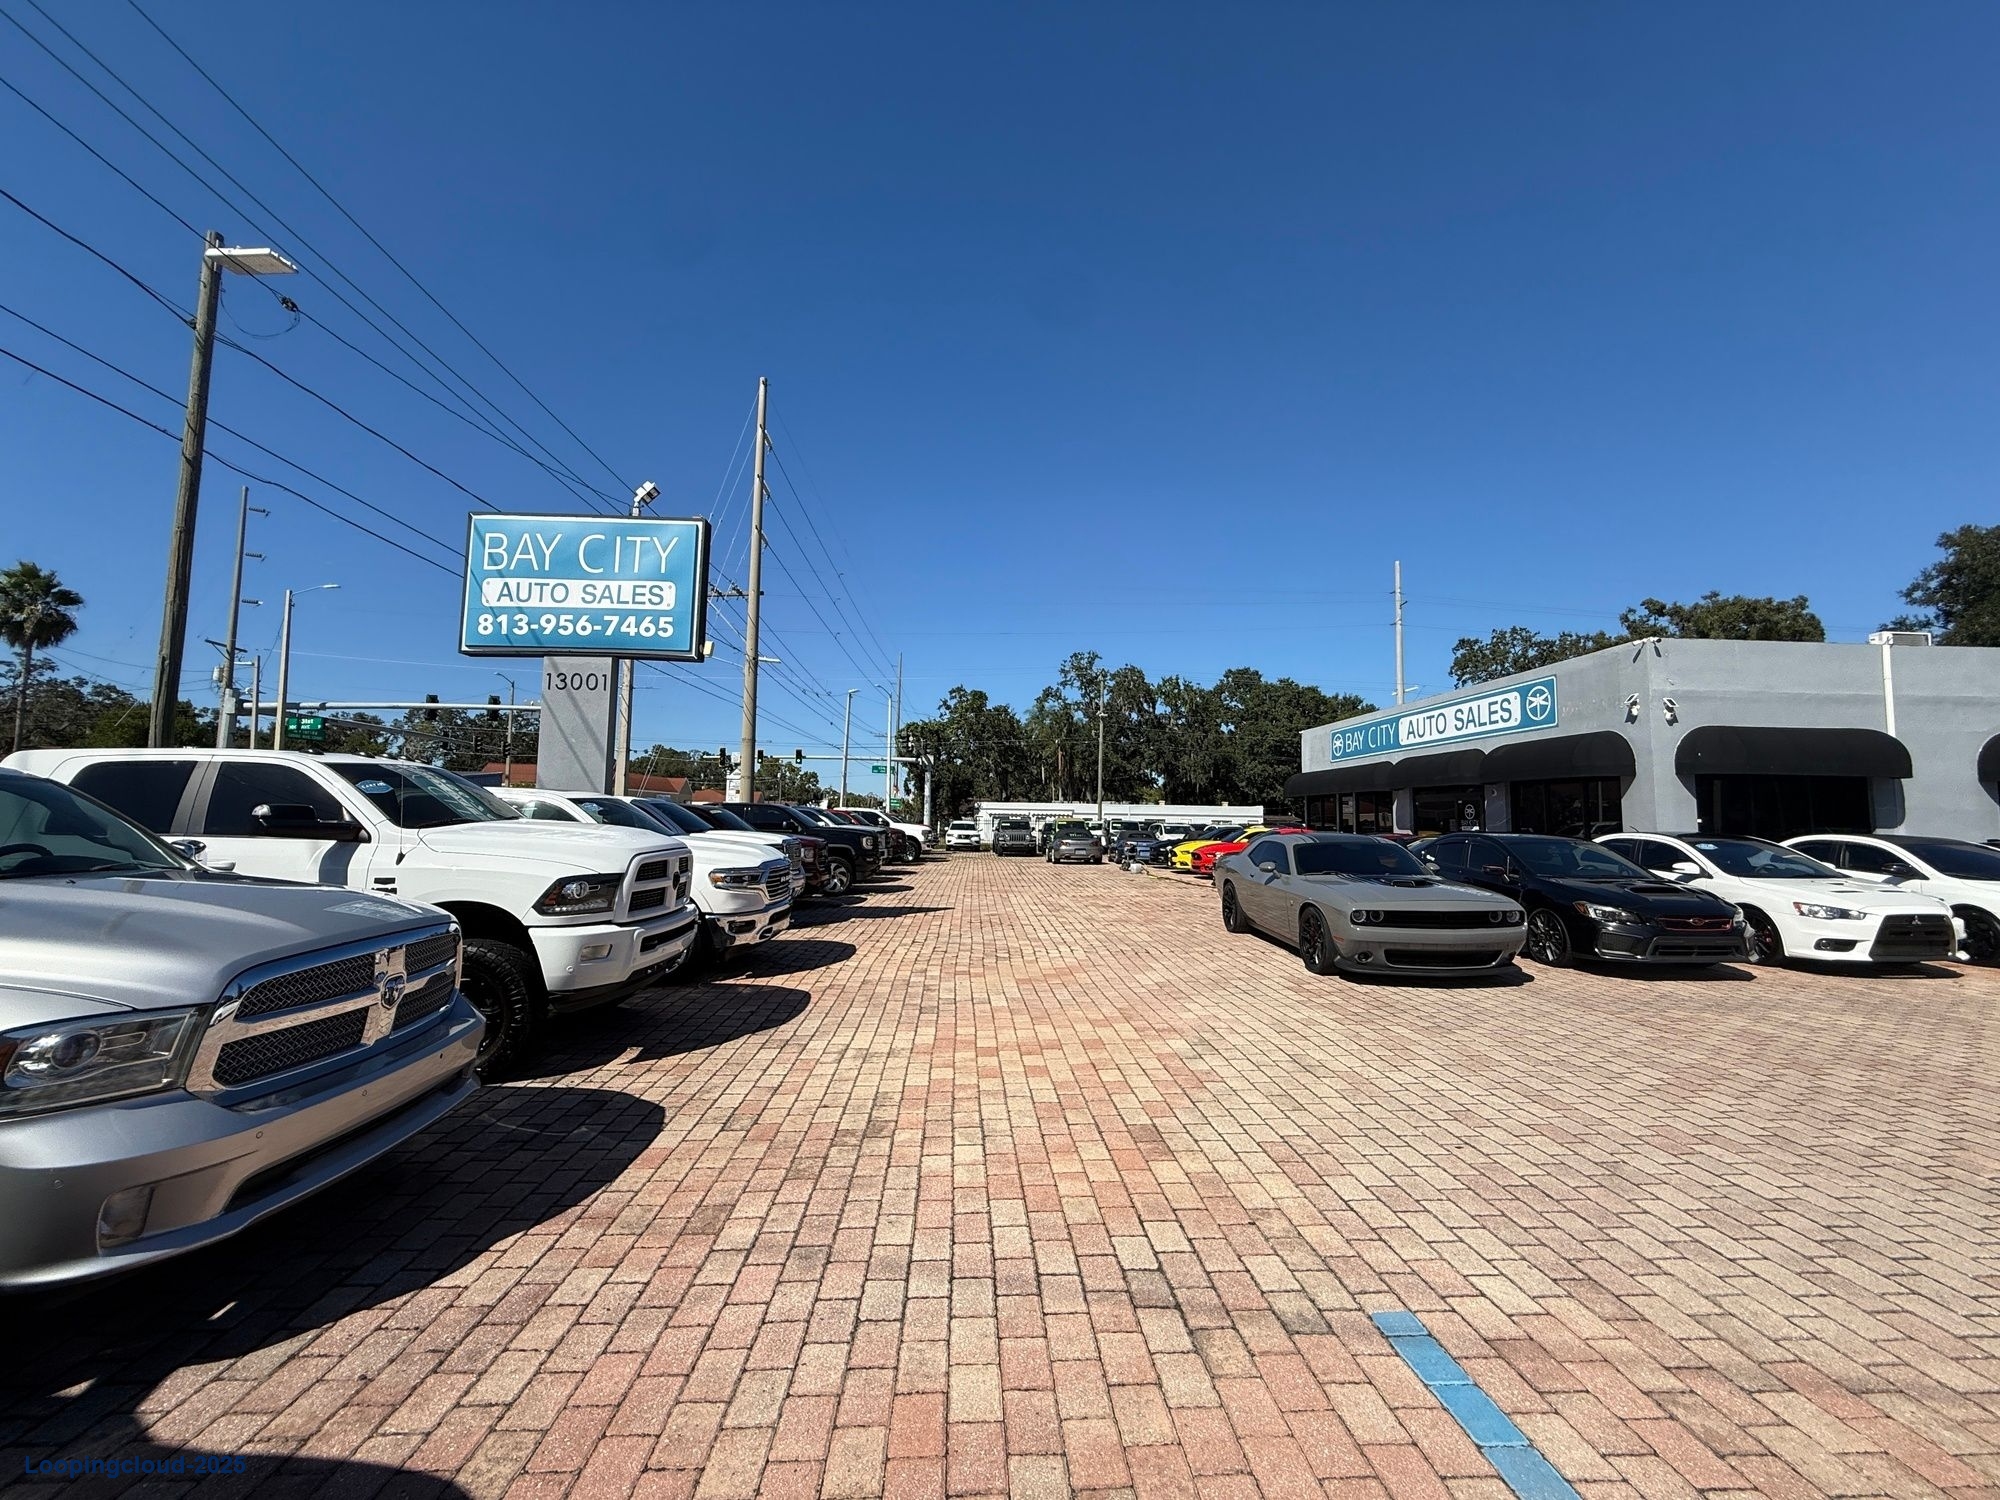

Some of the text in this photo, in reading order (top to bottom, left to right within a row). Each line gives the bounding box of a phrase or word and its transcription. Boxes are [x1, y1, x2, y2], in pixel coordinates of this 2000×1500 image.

[482, 532, 679, 574] BAY CITY
[496, 582, 664, 605] AUTO SALES
[477, 614, 674, 637] 813-956-7465
[546, 672, 609, 691] 13001
[1345, 698, 1512, 752] BAY CITY AUTO SALES
